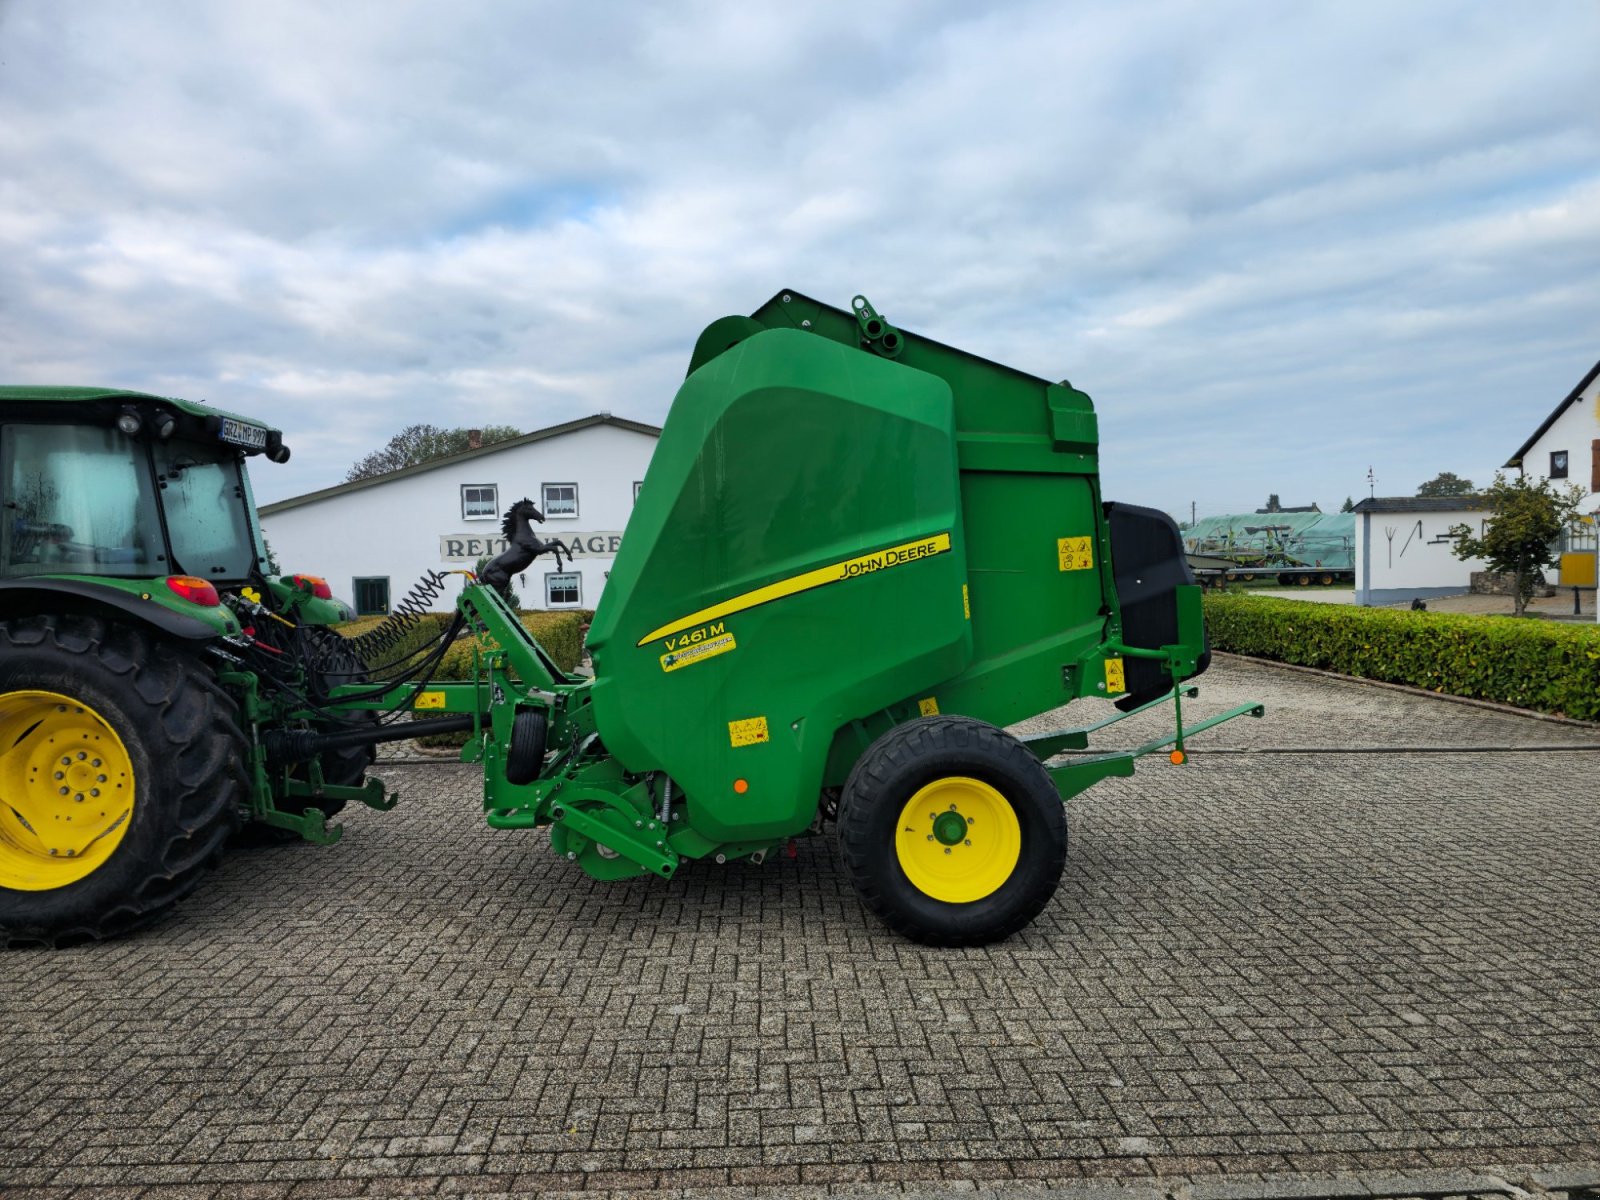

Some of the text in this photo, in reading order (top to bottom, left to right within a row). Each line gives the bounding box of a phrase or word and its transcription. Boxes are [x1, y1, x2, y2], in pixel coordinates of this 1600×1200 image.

[224, 420, 238, 438] GRZ
[839, 542, 937, 578] JOHN DEERE
[665, 638, 676, 651] V
[679, 628, 707, 646] 461
[710, 622, 725, 636] M
